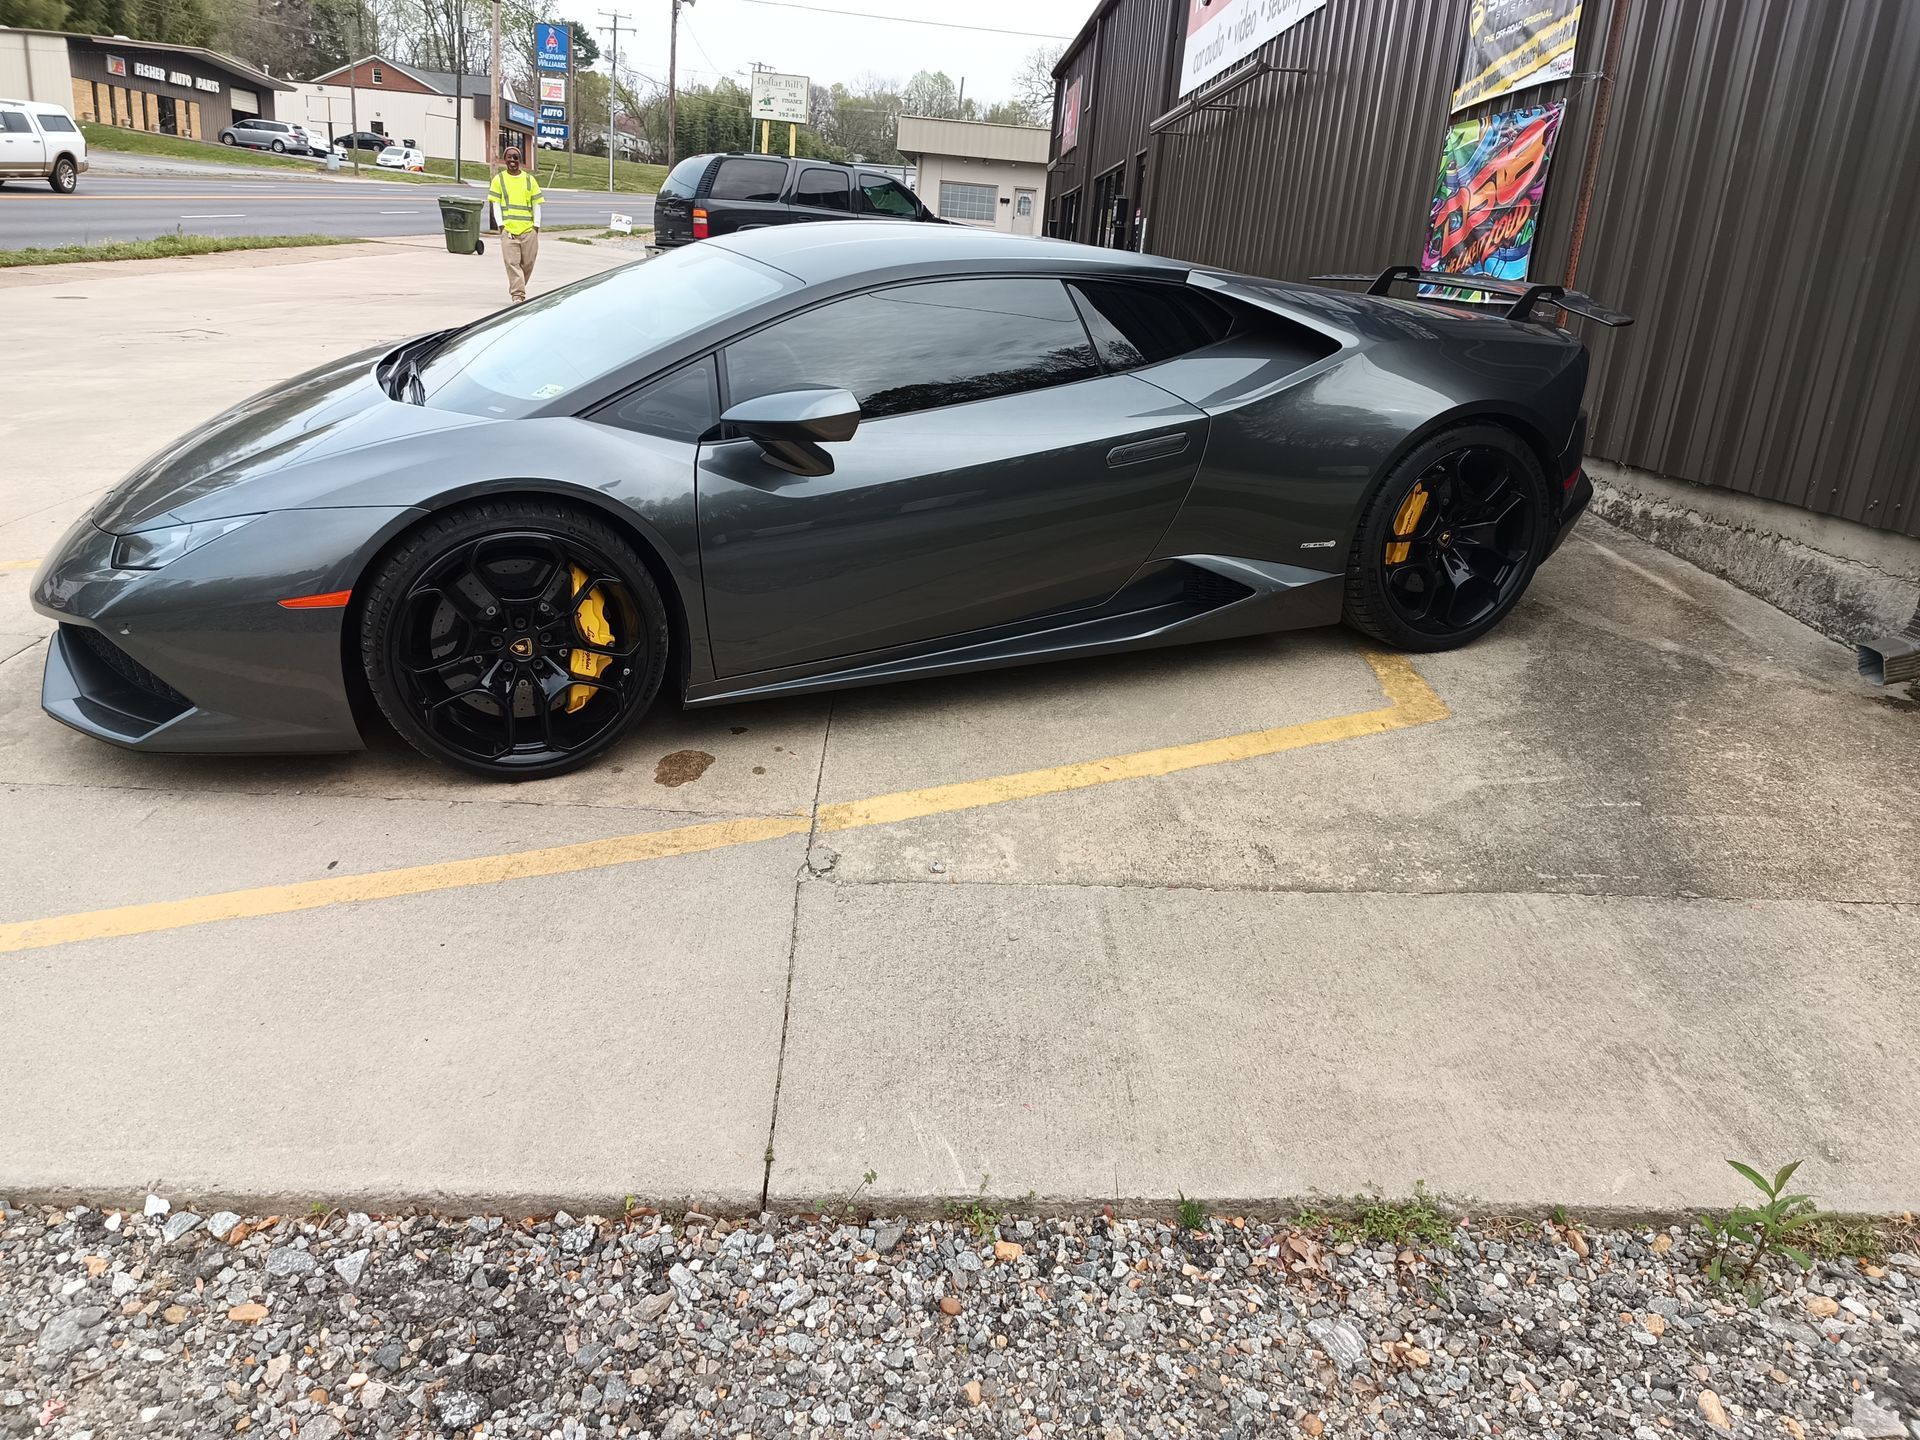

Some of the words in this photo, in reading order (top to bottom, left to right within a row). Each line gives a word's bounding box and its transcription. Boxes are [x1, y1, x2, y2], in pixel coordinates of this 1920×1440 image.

[1193, 48, 1205, 74] car
[1205, 23, 1224, 67] audio
[1234, 0, 1257, 46] video
[538, 51, 567, 61] SHERWIN
[1558, 58, 1572, 71] USA
[134, 62, 166, 81] FISHER
[169, 71, 192, 87] AUTO
[196, 77, 220, 93] PARTS
[757, 77, 782, 87] Dollar
[785, 80, 803, 89] Bill's
[542, 108, 563, 118] AUTO
[541, 126, 565, 136] PARTS
